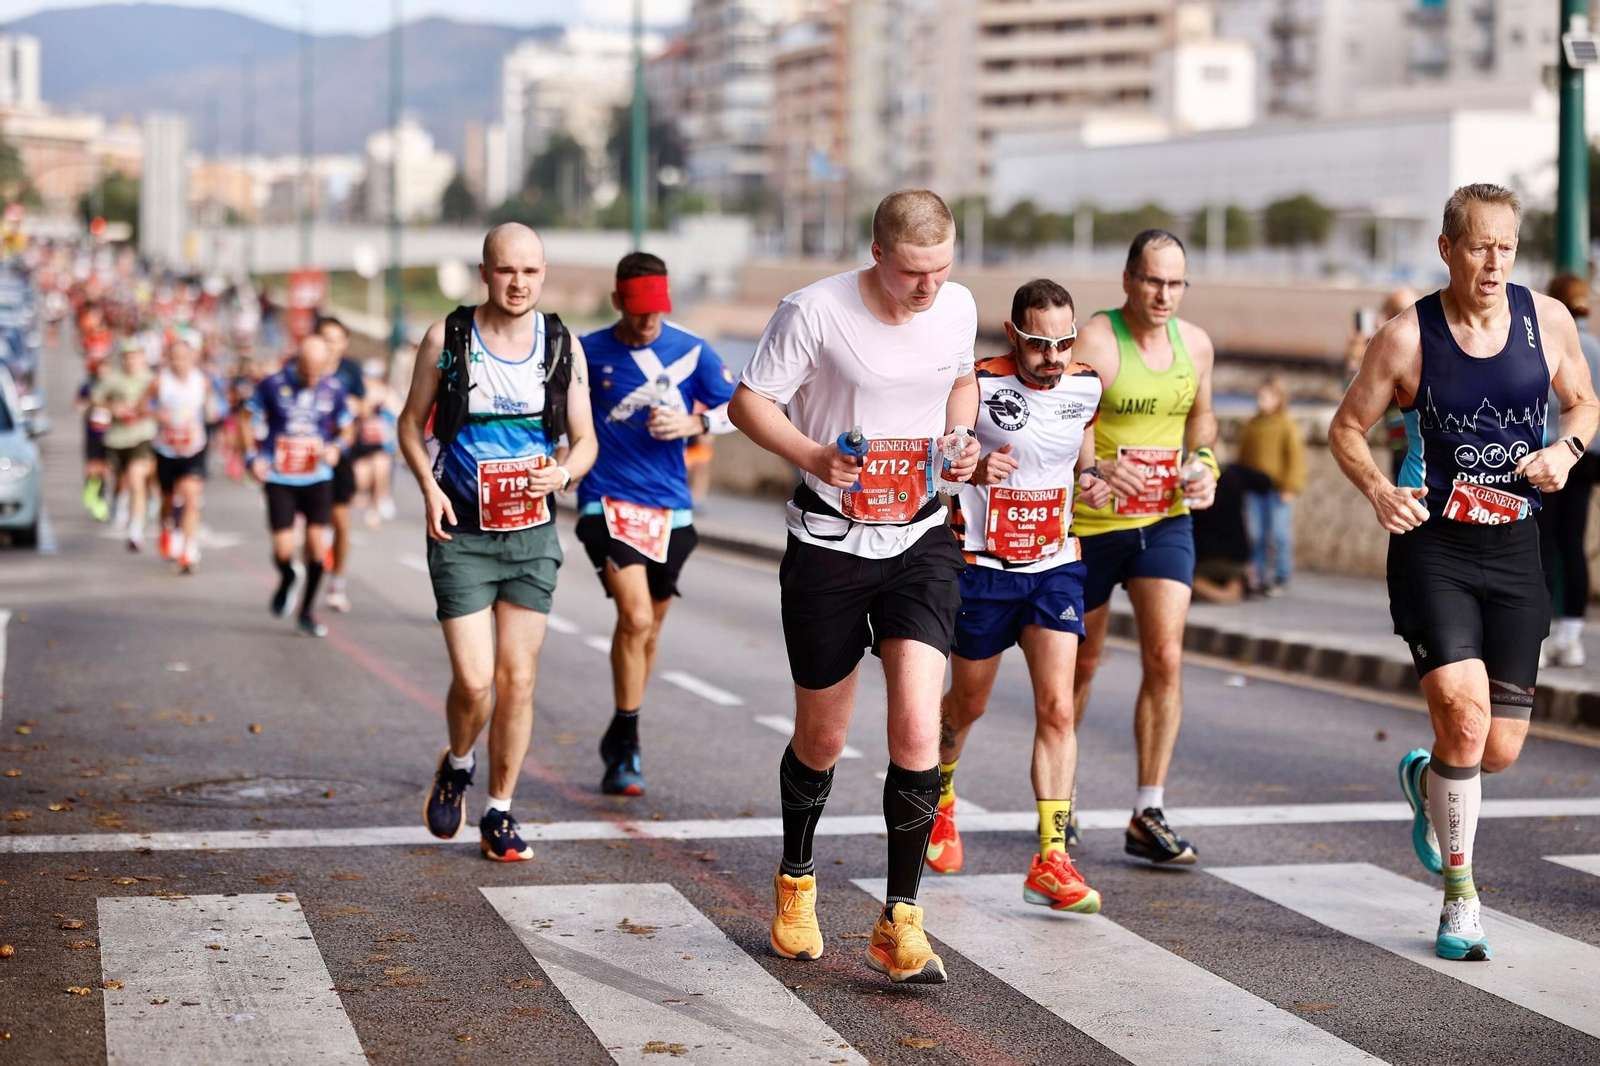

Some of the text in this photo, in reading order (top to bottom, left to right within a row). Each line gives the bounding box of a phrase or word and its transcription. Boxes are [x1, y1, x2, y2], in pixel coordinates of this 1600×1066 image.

[1116, 399, 1158, 415] JAMIE
[872, 440, 923, 452] GENERALI
[867, 459, 910, 475] 4712
[1012, 490, 1059, 501] GENERALI
[1008, 507, 1048, 522] 6343
